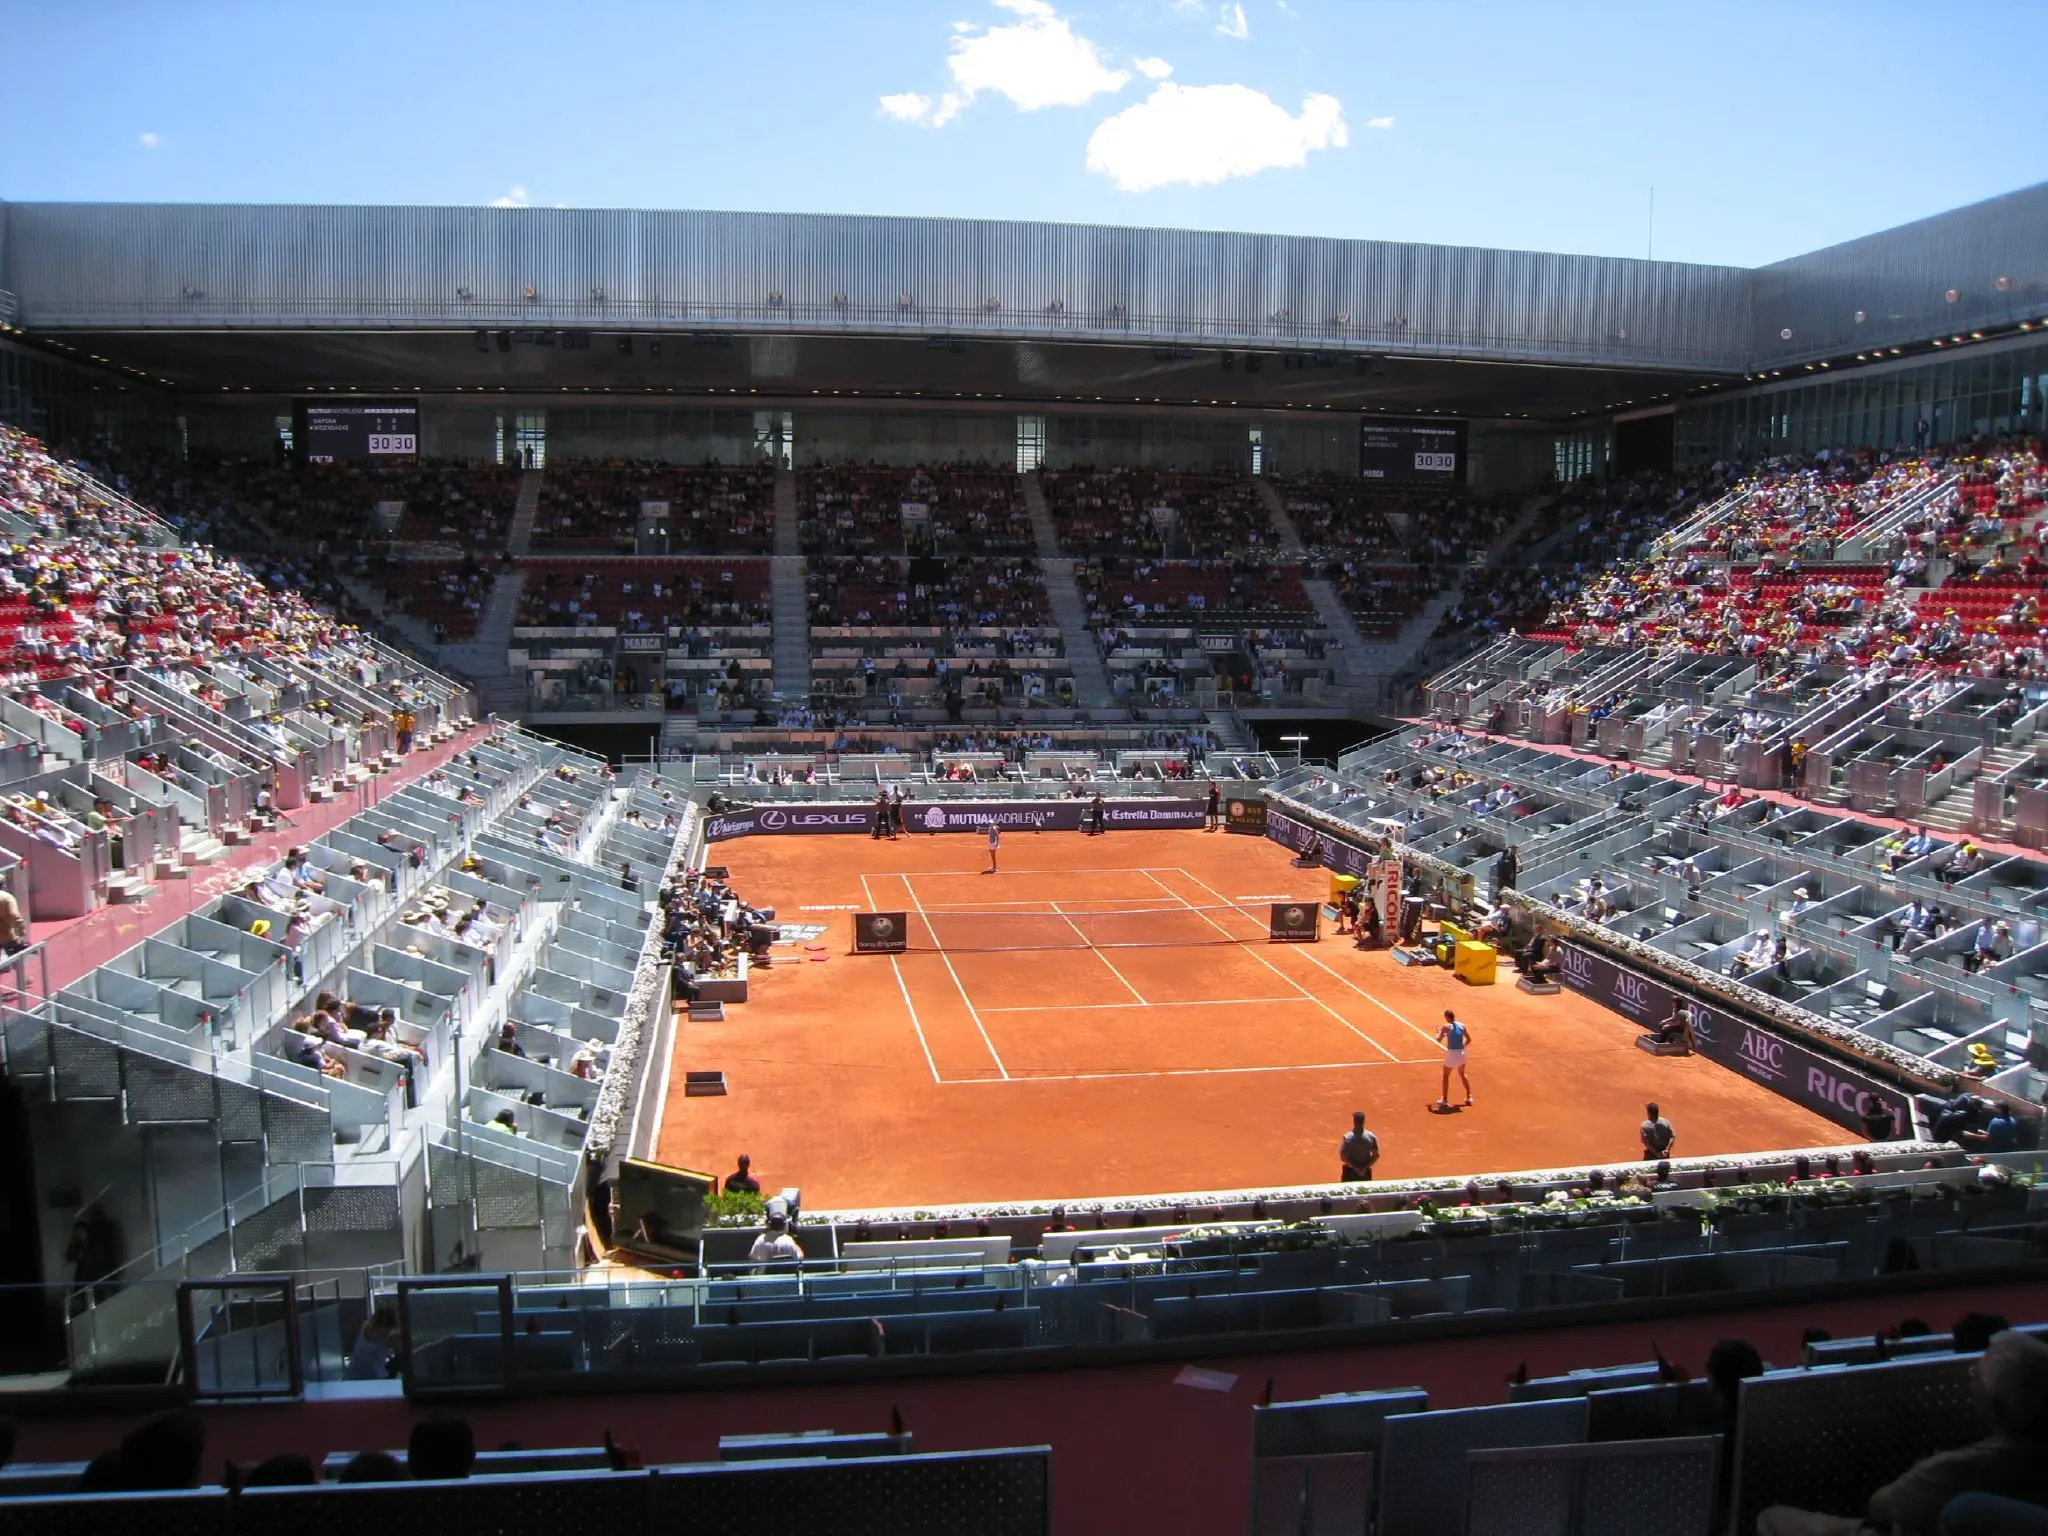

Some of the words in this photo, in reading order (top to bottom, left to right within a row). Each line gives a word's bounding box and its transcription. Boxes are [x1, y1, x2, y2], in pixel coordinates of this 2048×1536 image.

[371, 437, 390, 449] 30
[395, 437, 413, 449] 30
[1417, 455, 1433, 466] 30
[1436, 456, 1452, 467] 30
[623, 638, 661, 649] MARCA
[1201, 638, 1234, 649] MARCA
[791, 813, 866, 825] LEXUS
[1112, 809, 1148, 820] Estrella
[1149, 809, 1180, 820] Damm
[1266, 812, 1290, 834] RICOH
[1386, 870, 1399, 930] RICOH
[1562, 948, 1593, 978] ABC
[1614, 972, 1648, 1005] ABC
[1687, 1003, 1712, 1034] BC
[1740, 1029, 1783, 1069] ABC
